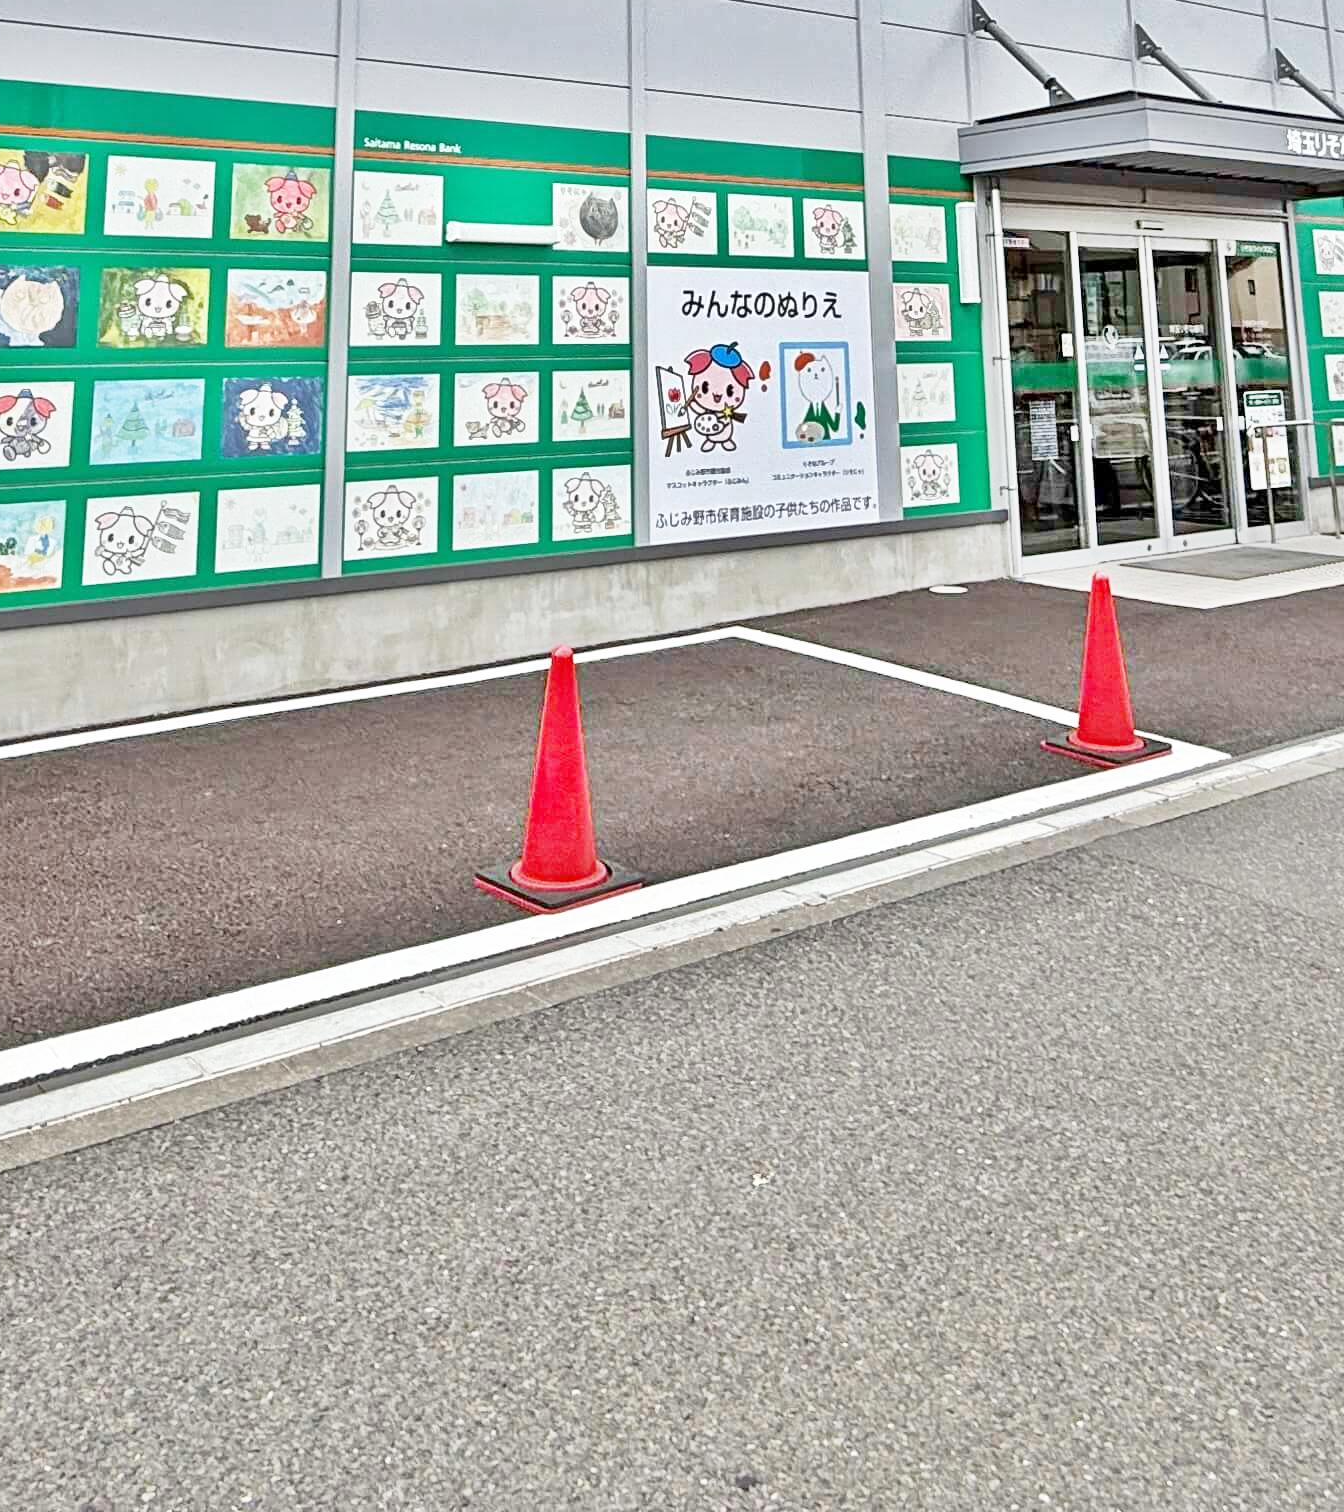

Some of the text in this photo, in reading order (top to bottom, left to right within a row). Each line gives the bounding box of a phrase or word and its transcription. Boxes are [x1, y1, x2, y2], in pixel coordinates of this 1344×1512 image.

[363, 136, 462, 154] Saitama Resona Bank
[681, 289, 843, 319] みんなのぬりえ
[655, 495, 877, 529] ふじみ野市保育施設の子供たちの作品です。
